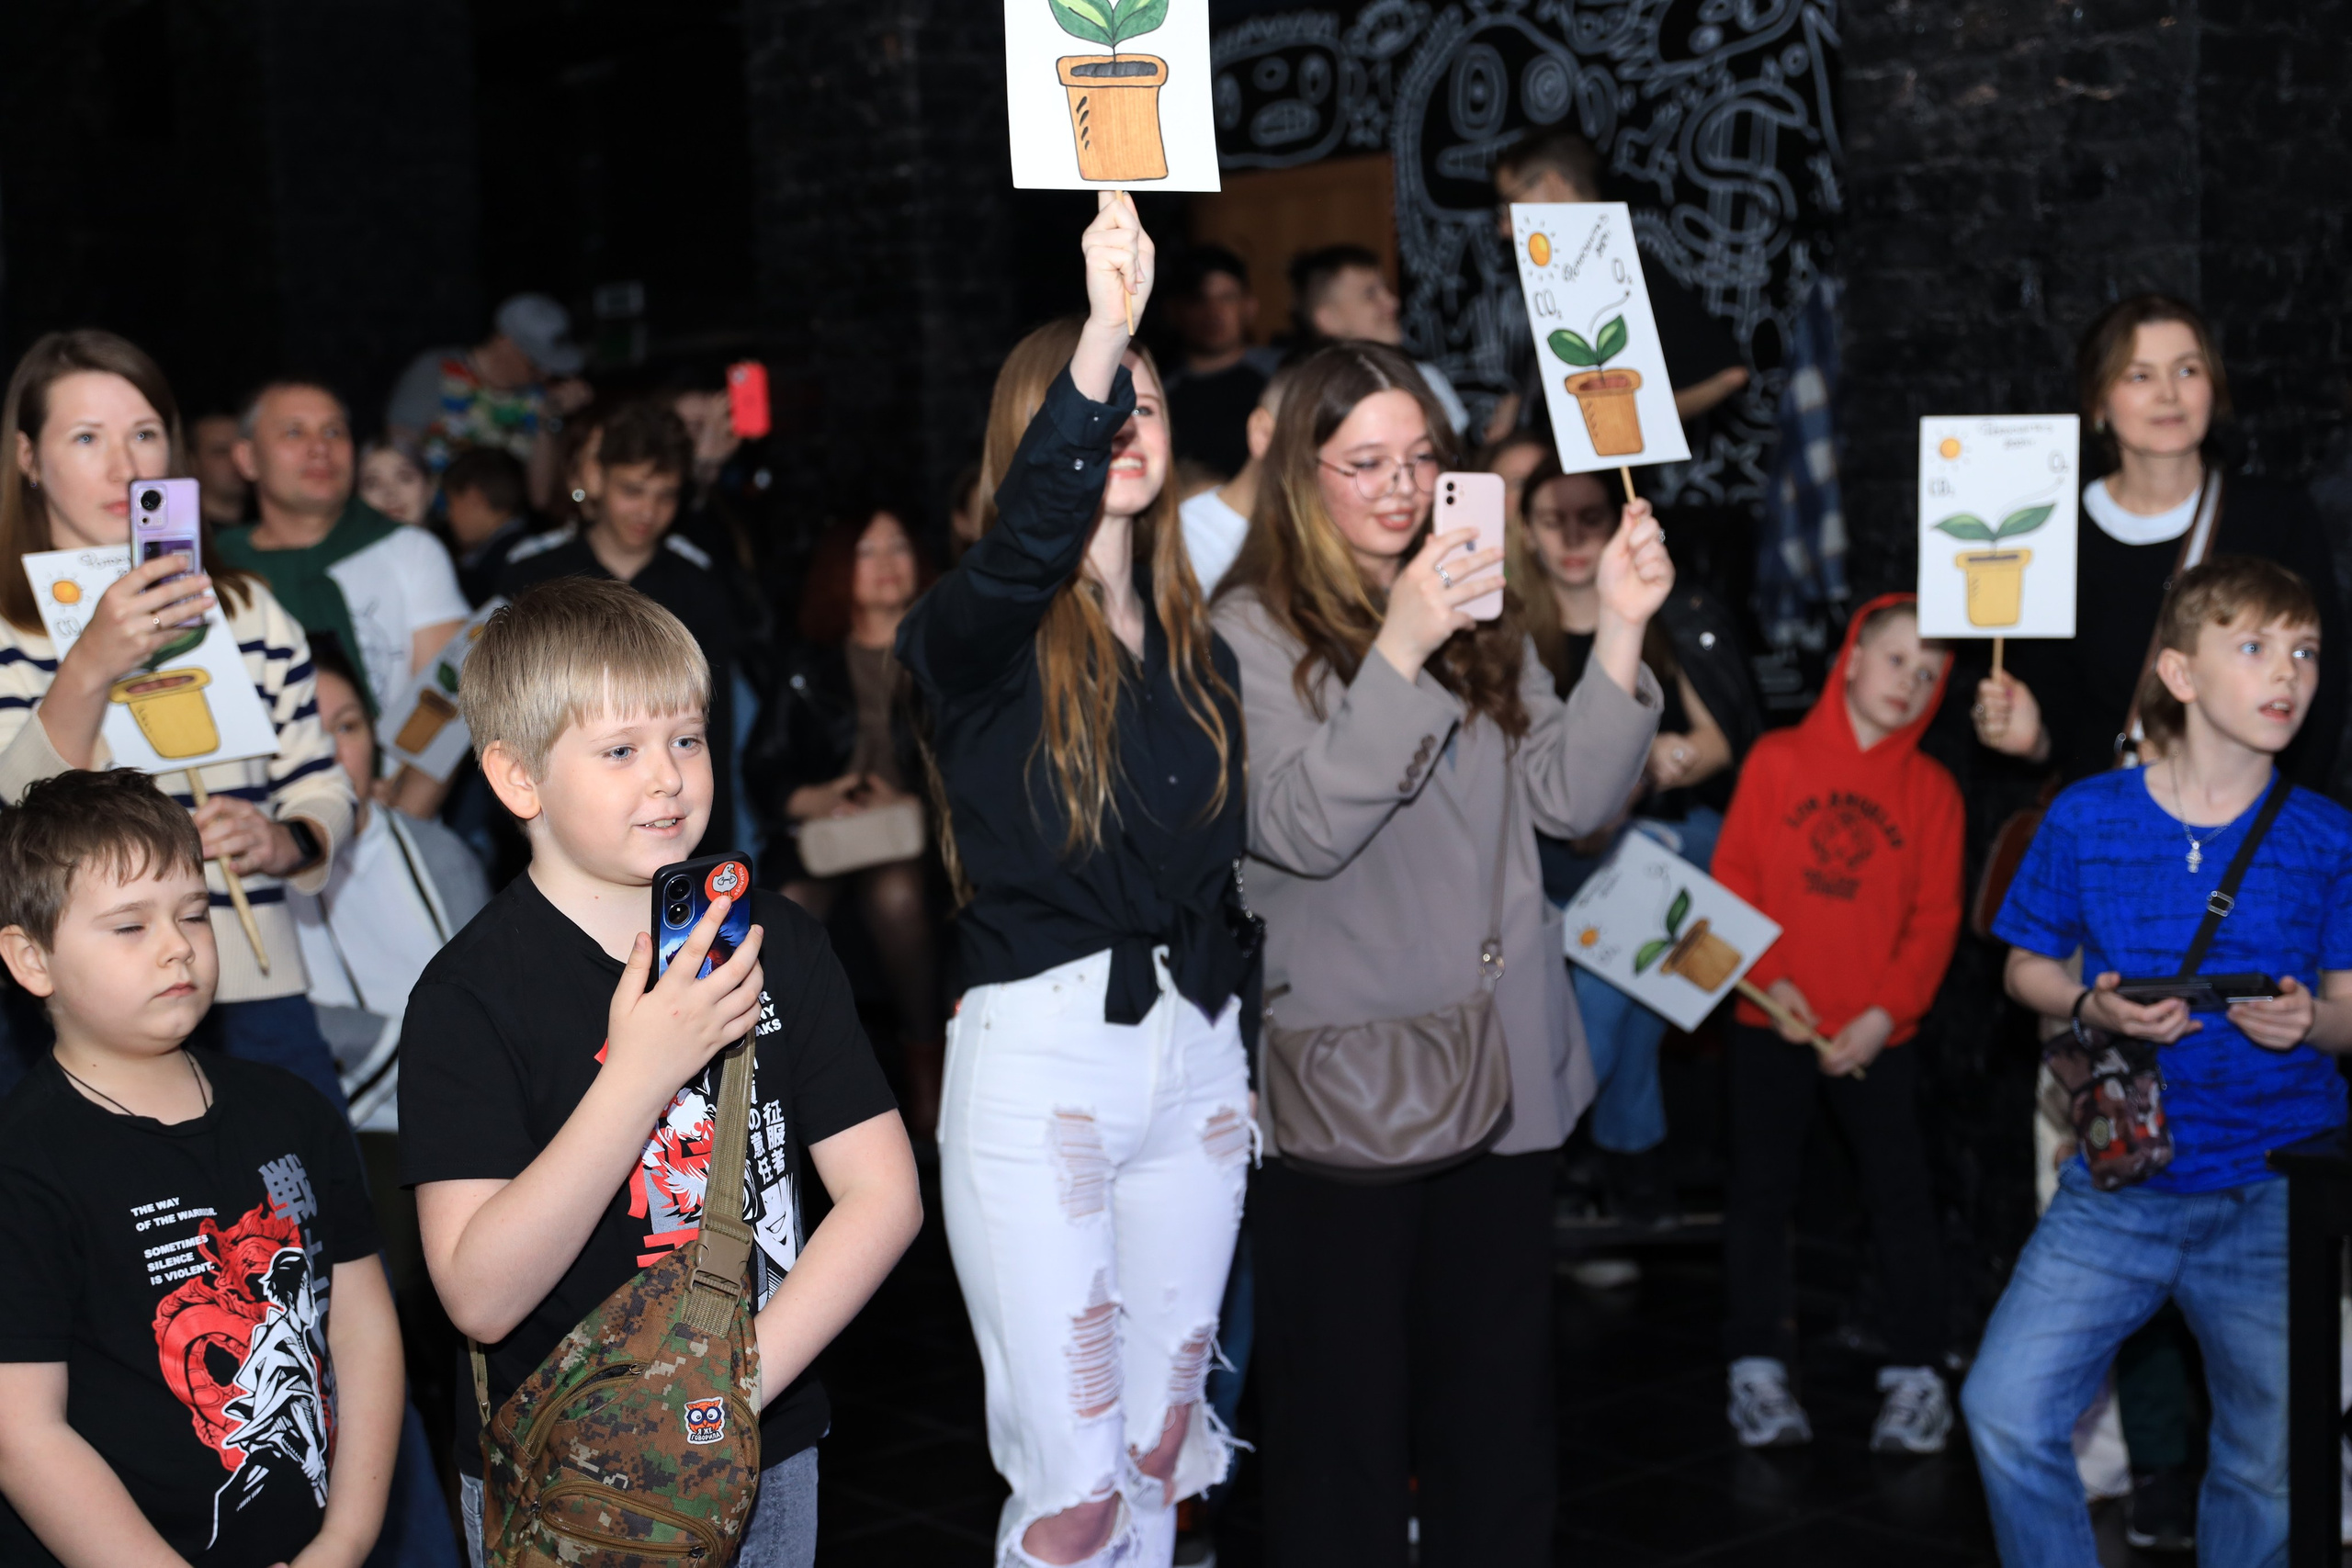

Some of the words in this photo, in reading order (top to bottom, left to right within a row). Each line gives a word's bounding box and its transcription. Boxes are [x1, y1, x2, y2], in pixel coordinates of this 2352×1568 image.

[763, 1100, 786, 1176] 征服者
[130, 1203, 155, 1217] THE
[155, 1197, 180, 1211] WAY
[135, 1219, 152, 1232] OF
[153, 1213, 176, 1227] THE
[143, 1234, 209, 1258] SOMETIMES
[147, 1251, 195, 1272] SILENCE
[150, 1274, 164, 1286] IS
[164, 1260, 215, 1282] VIOLENT.
